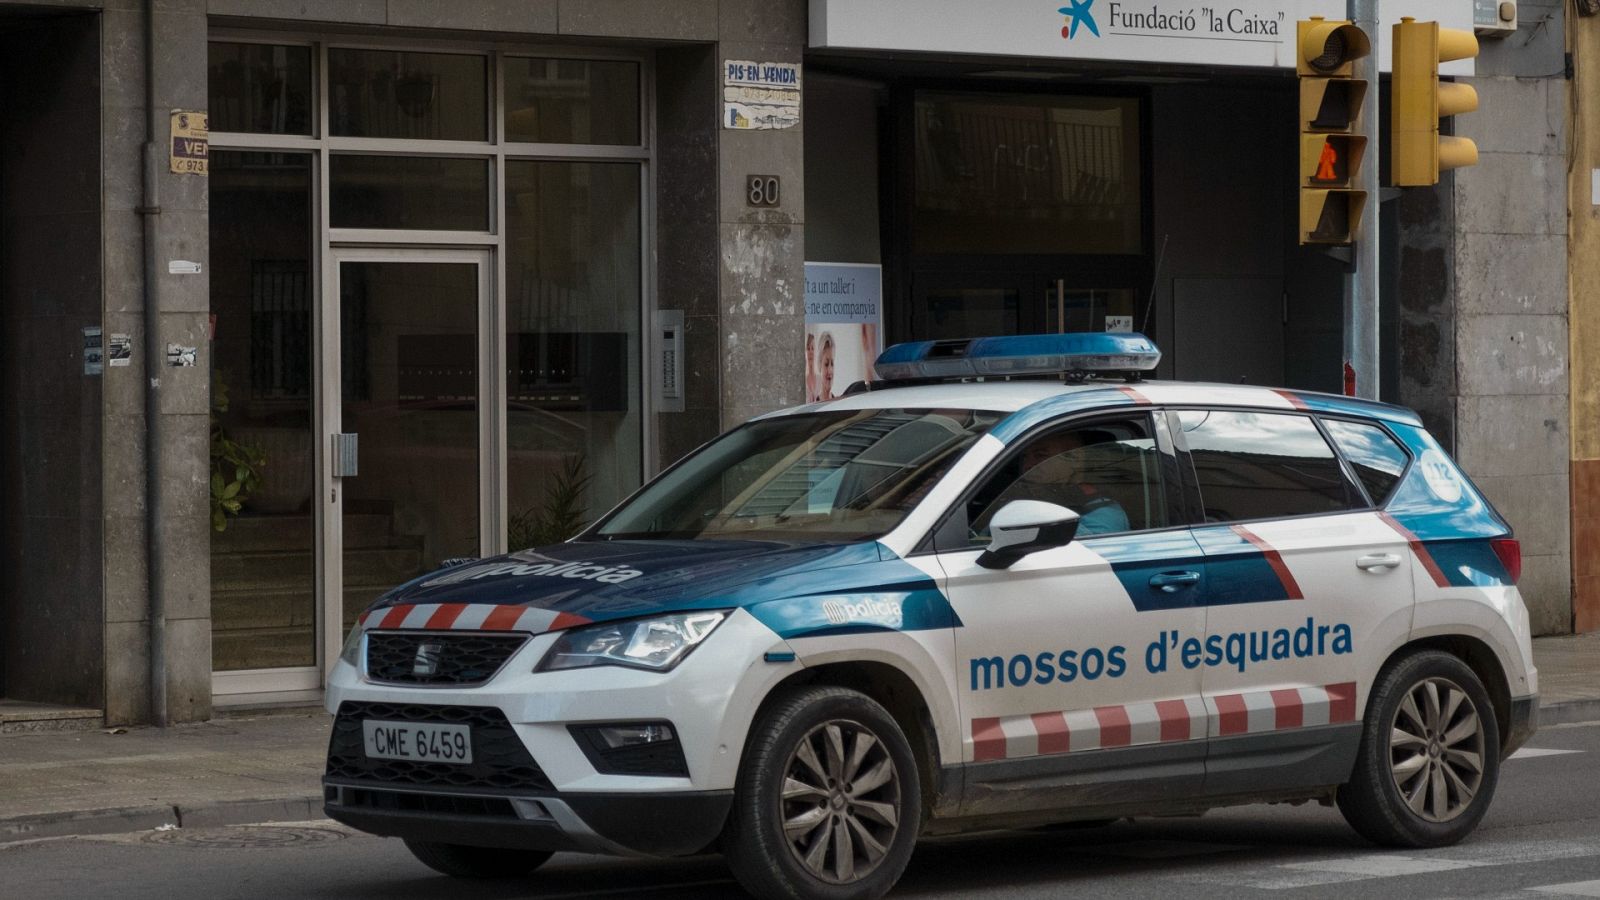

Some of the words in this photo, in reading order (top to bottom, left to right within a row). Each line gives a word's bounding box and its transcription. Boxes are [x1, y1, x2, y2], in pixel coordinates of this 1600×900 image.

[1109, 3, 1196, 31] Fundació
[728, 64, 744, 80] PIS
[747, 66, 760, 81] EN
[763, 66, 796, 84] VENDA
[186, 160, 203, 171] 973
[751, 177, 779, 204] 80
[812, 282, 817, 294] a
[819, 282, 829, 294] un
[831, 278, 851, 295] taller
[822, 302, 832, 315] en
[834, 298, 876, 319] companyia
[475, 562, 643, 583] policia
[845, 598, 902, 620] policia
[970, 645, 1127, 691] mossos
[1145, 617, 1352, 673] d'esquadra
[375, 728, 409, 756] CME
[416, 730, 466, 759] 6459
